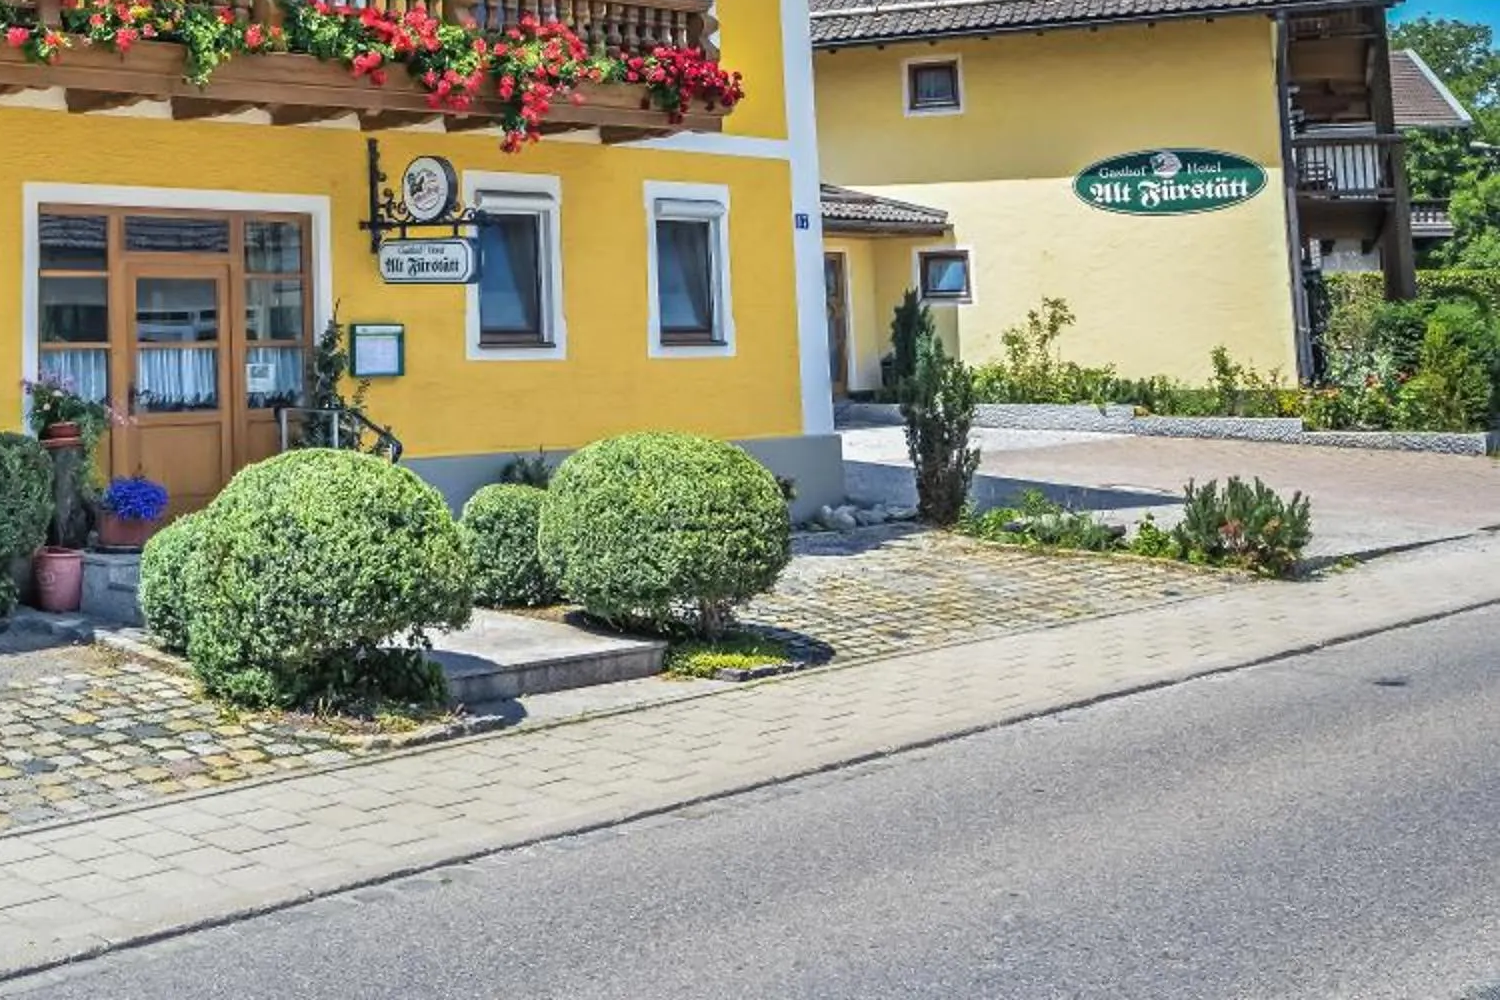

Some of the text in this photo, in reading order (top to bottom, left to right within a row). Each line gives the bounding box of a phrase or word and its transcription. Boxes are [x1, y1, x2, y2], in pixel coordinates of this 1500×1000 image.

[1098, 161, 1222, 179] Gasthof Hotel
[1089, 176, 1249, 209] Alt Fürstätt
[385, 256, 460, 277] Alt Fürstätt
